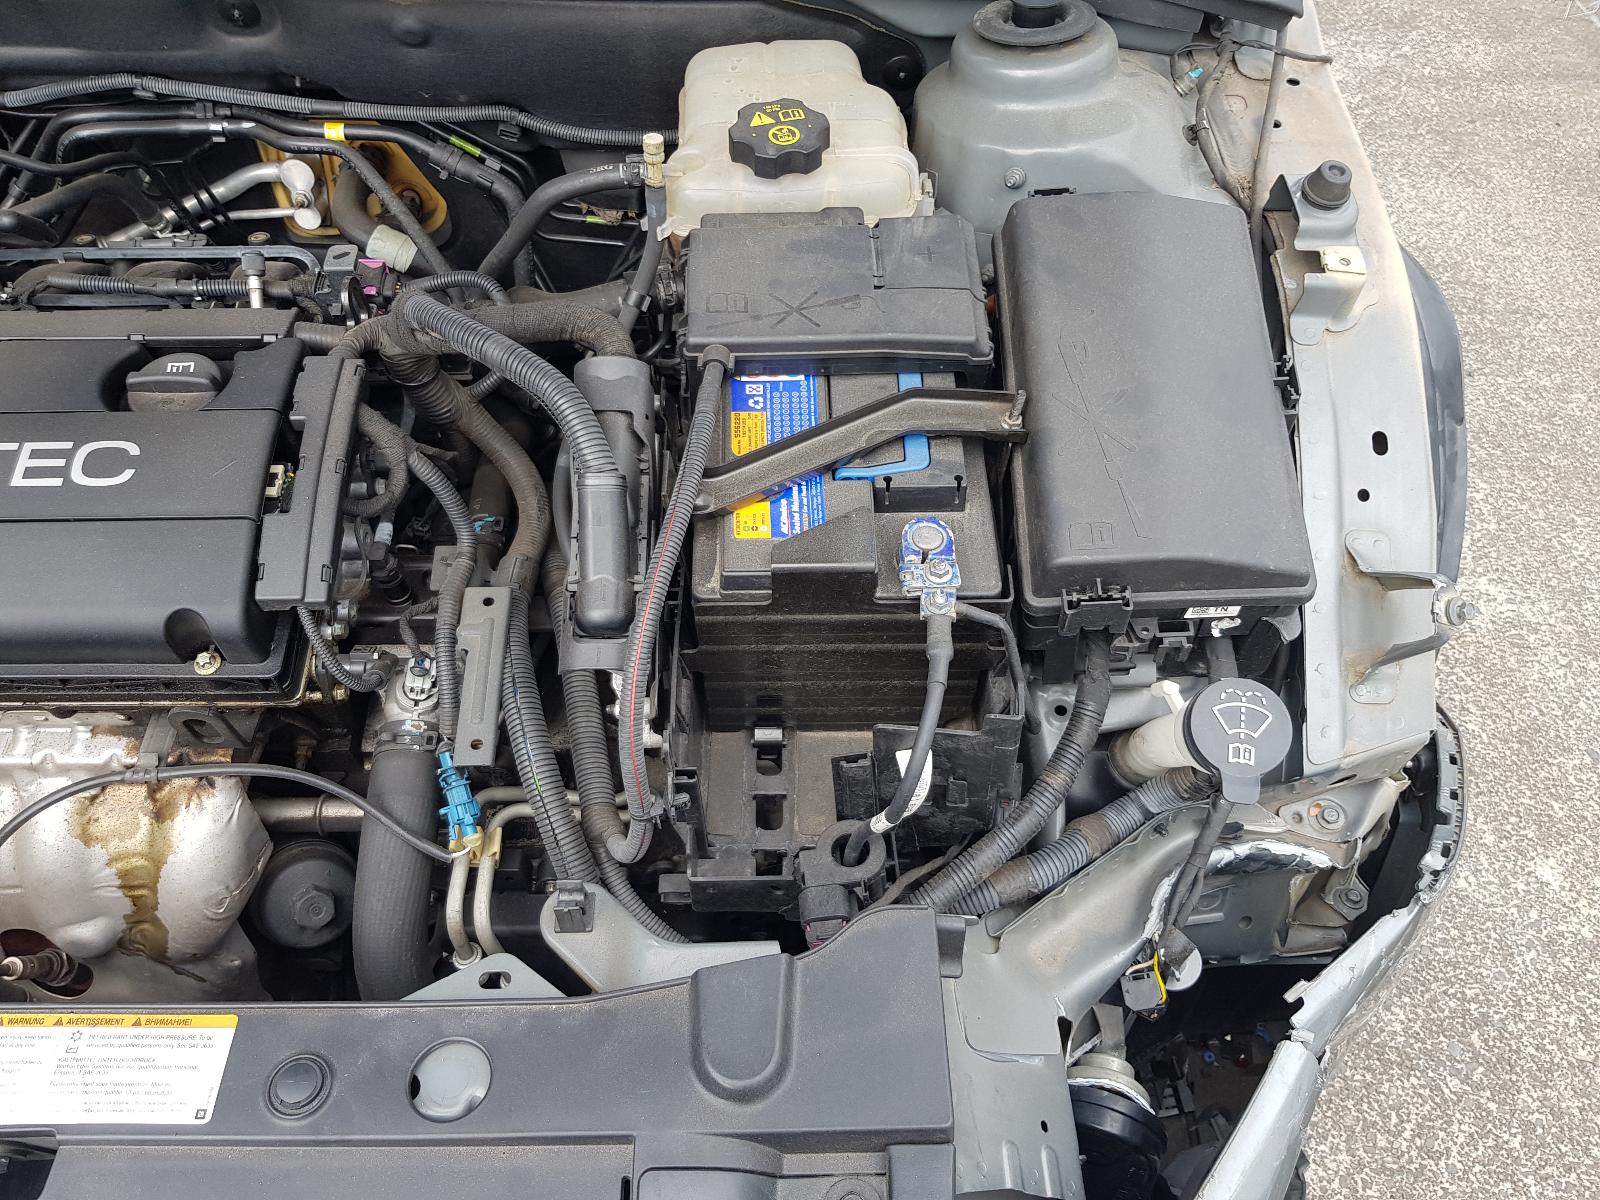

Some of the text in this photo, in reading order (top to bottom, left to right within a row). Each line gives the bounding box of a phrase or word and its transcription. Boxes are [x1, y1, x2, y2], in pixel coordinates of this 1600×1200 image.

[791, 512, 801, 535] Sealed
[7, 1017, 126, 1027] WARNUNG AVERTISSEMENT
[144, 1018, 193, 1026] ВНИМАНИЕ!
